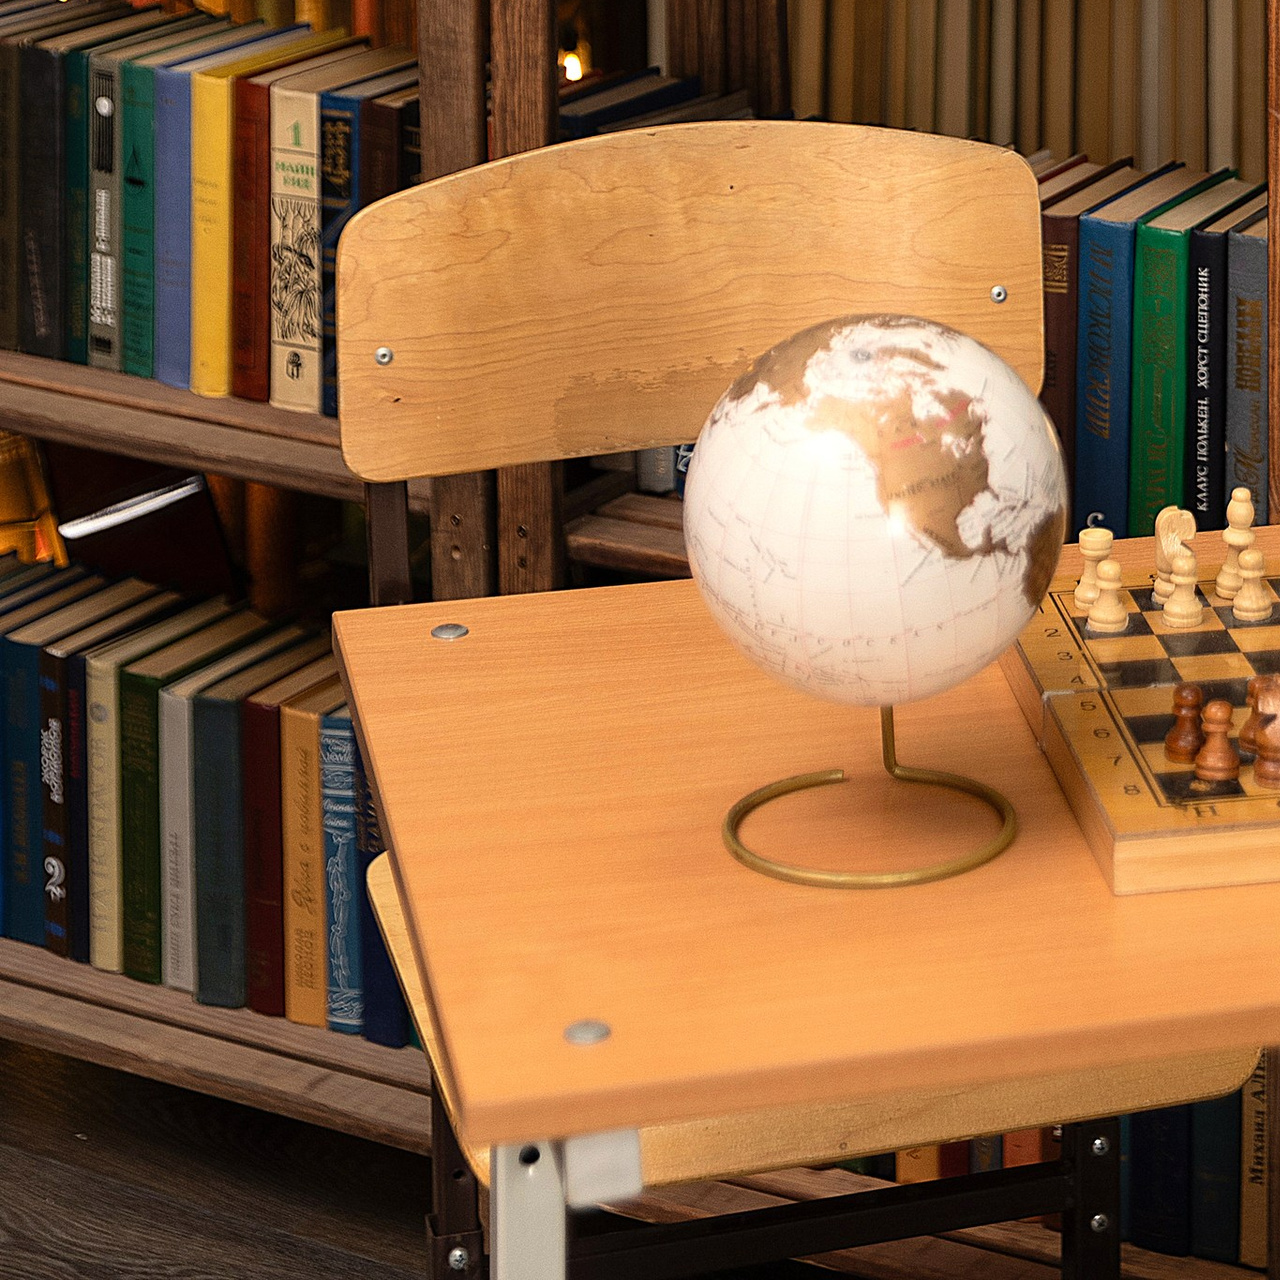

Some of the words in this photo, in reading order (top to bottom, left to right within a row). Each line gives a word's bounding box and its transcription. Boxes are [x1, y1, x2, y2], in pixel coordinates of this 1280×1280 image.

[286, 119, 303, 148] 1
[274, 161, 316, 177] МАЙН
[1197, 267, 1210, 344] СЦЕПОНИК
[1085, 270, 1114, 439] ИСАКОВСКИЙ
[1196, 344, 1210, 390] ХОРСТ
[1196, 466, 1210, 512] КЛАУС
[1044, 627, 1061, 639] 2
[1056, 650, 1073, 662] 3
[1070, 674, 1085, 686] 4
[1080, 700, 1097, 713] 5
[1092, 727, 1111, 740] 6
[1106, 754, 1123, 767] 7
[1123, 783, 1141, 797] 8
[1192, 804, 1220, 819] H
[43, 855, 66, 902] 2
[1247, 1110, 1266, 1186] Михаил
